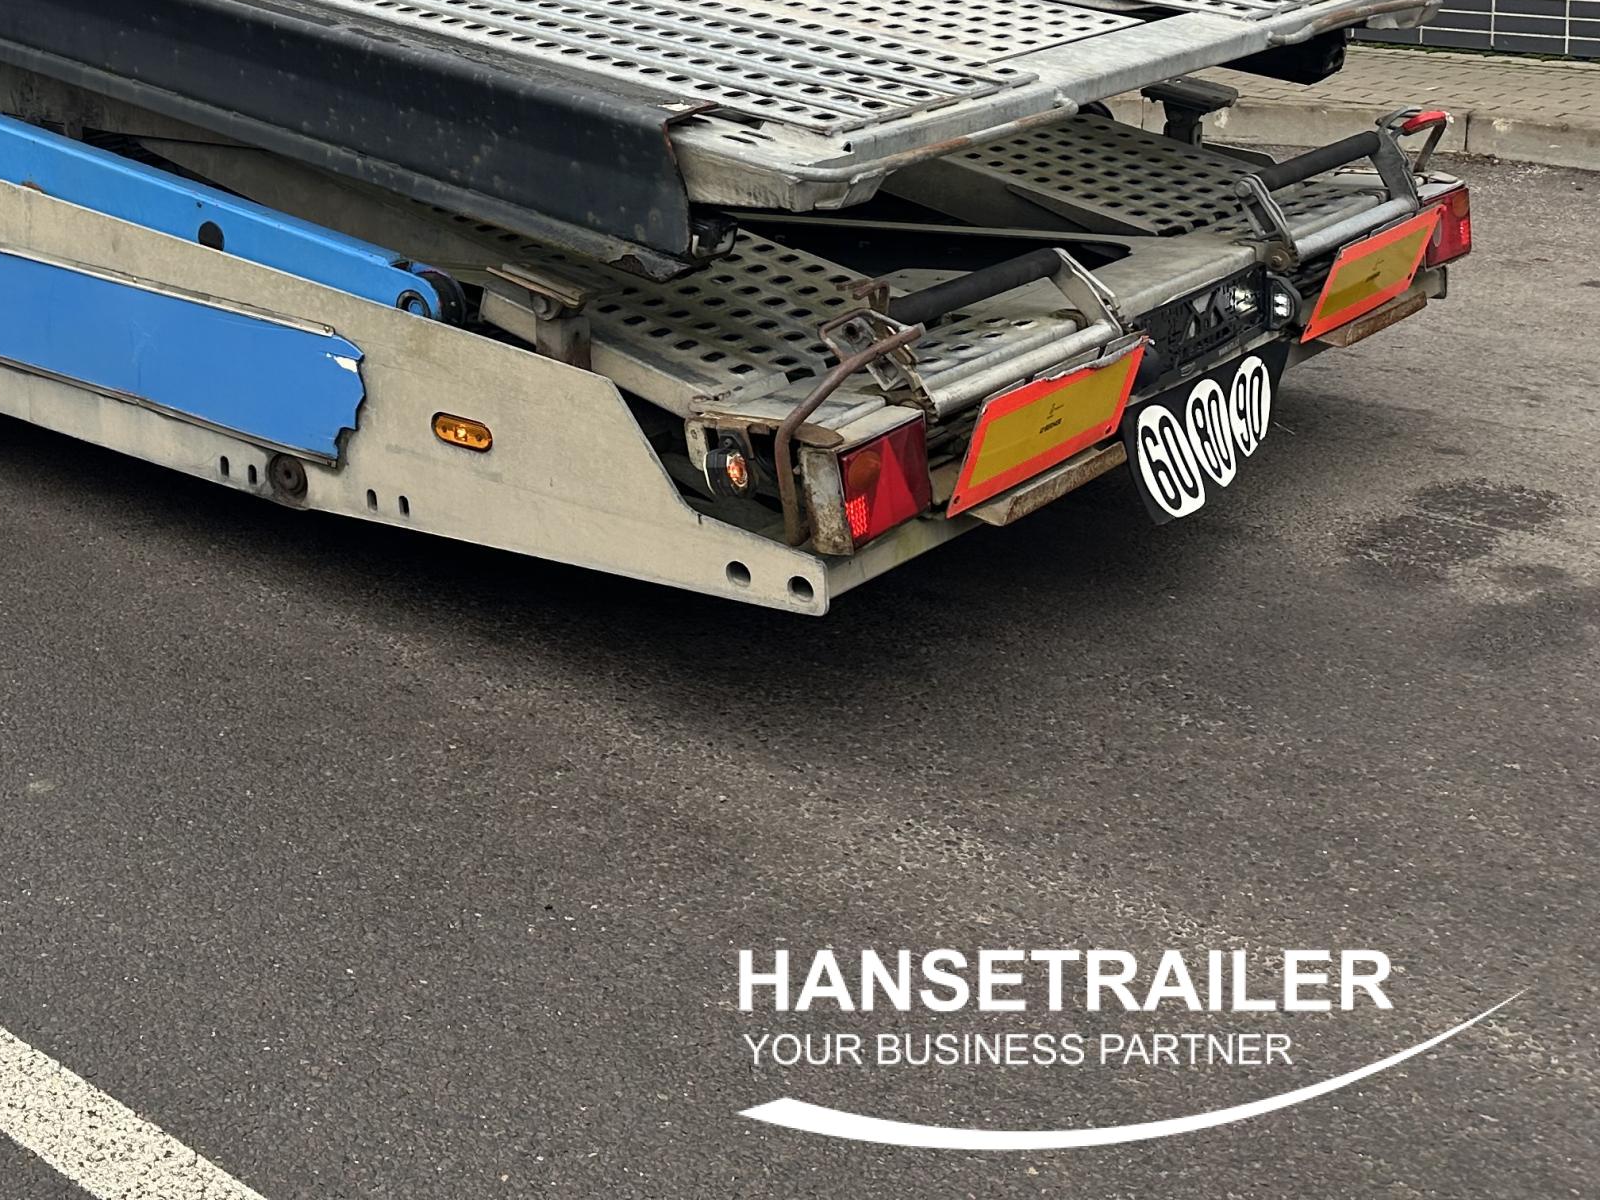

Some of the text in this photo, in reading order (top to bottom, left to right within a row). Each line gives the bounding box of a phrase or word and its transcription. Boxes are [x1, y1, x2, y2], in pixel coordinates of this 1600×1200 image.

[1191, 389, 1232, 479] 80
[1236, 366, 1264, 453] 90
[1141, 415, 1200, 511] 60
